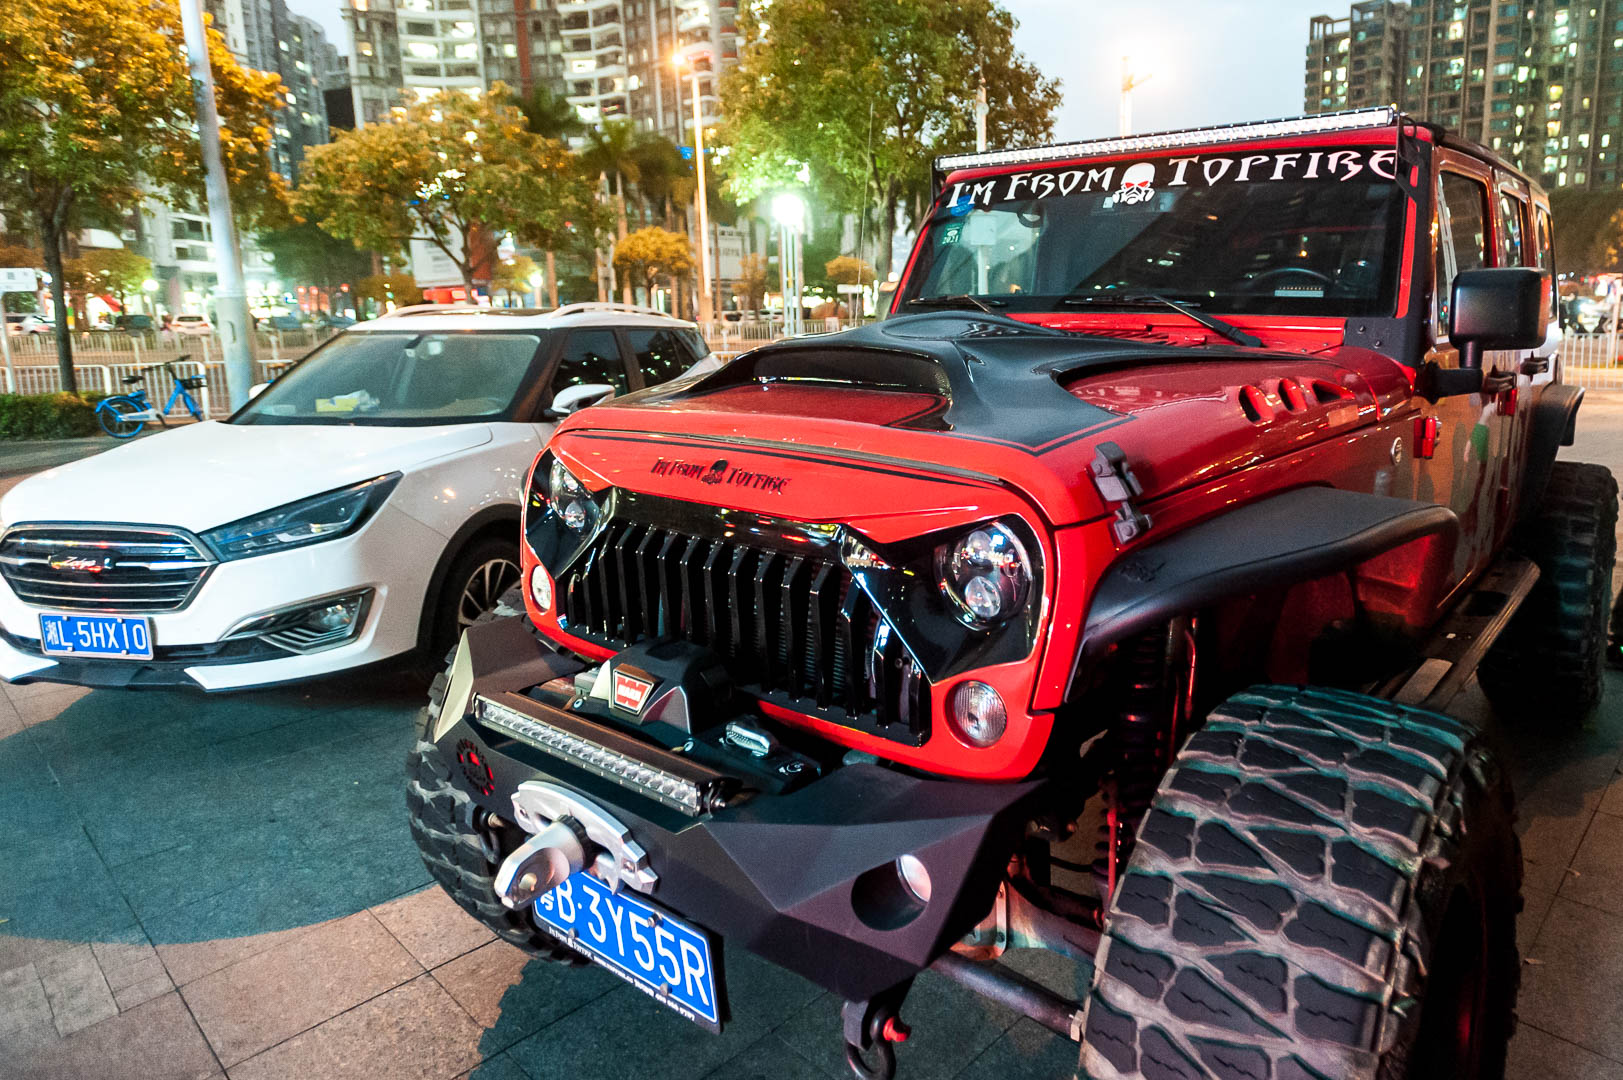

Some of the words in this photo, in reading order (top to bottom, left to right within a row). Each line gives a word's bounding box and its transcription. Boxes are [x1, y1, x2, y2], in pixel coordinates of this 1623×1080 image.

[946, 180, 997, 208] I'M
[1004, 166, 1116, 200] FROM
[1168, 150, 1397, 187] TOPFIRE
